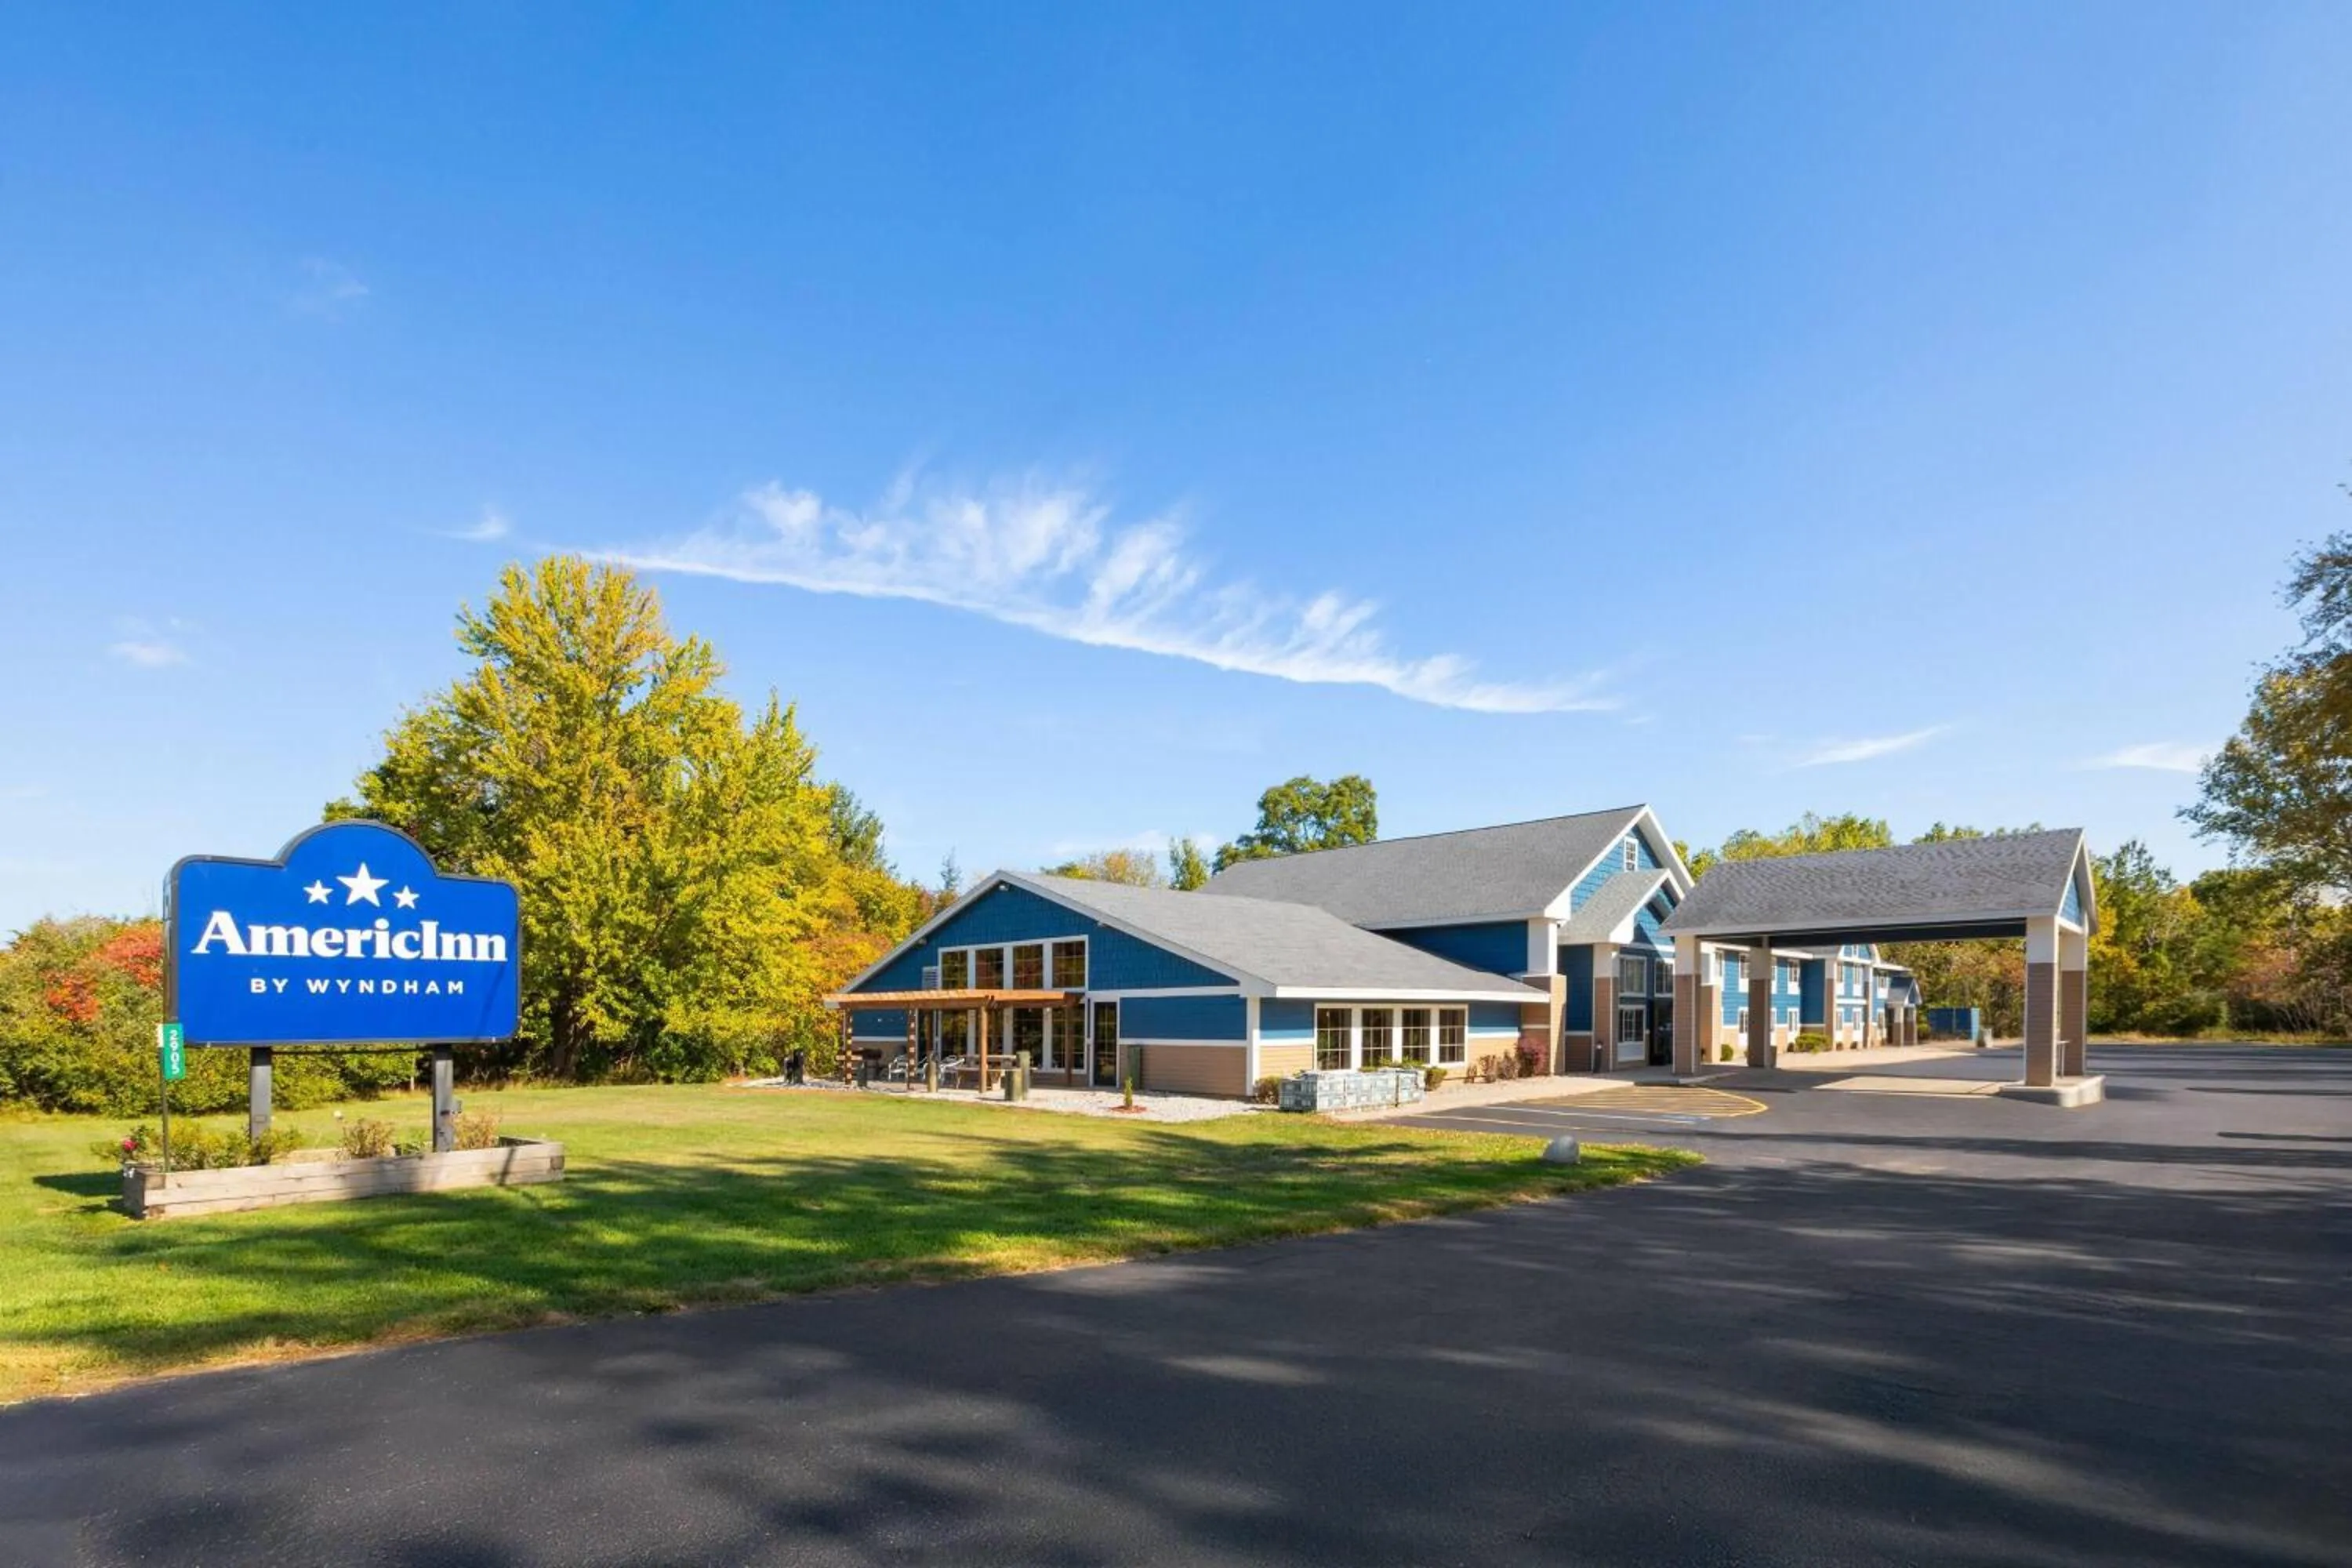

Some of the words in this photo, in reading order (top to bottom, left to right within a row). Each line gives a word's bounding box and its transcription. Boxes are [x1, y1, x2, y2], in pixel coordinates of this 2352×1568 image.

[192, 910, 507, 962] AmericInn
[250, 978, 289, 993] BY
[307, 978, 465, 994] WYNDHAM
